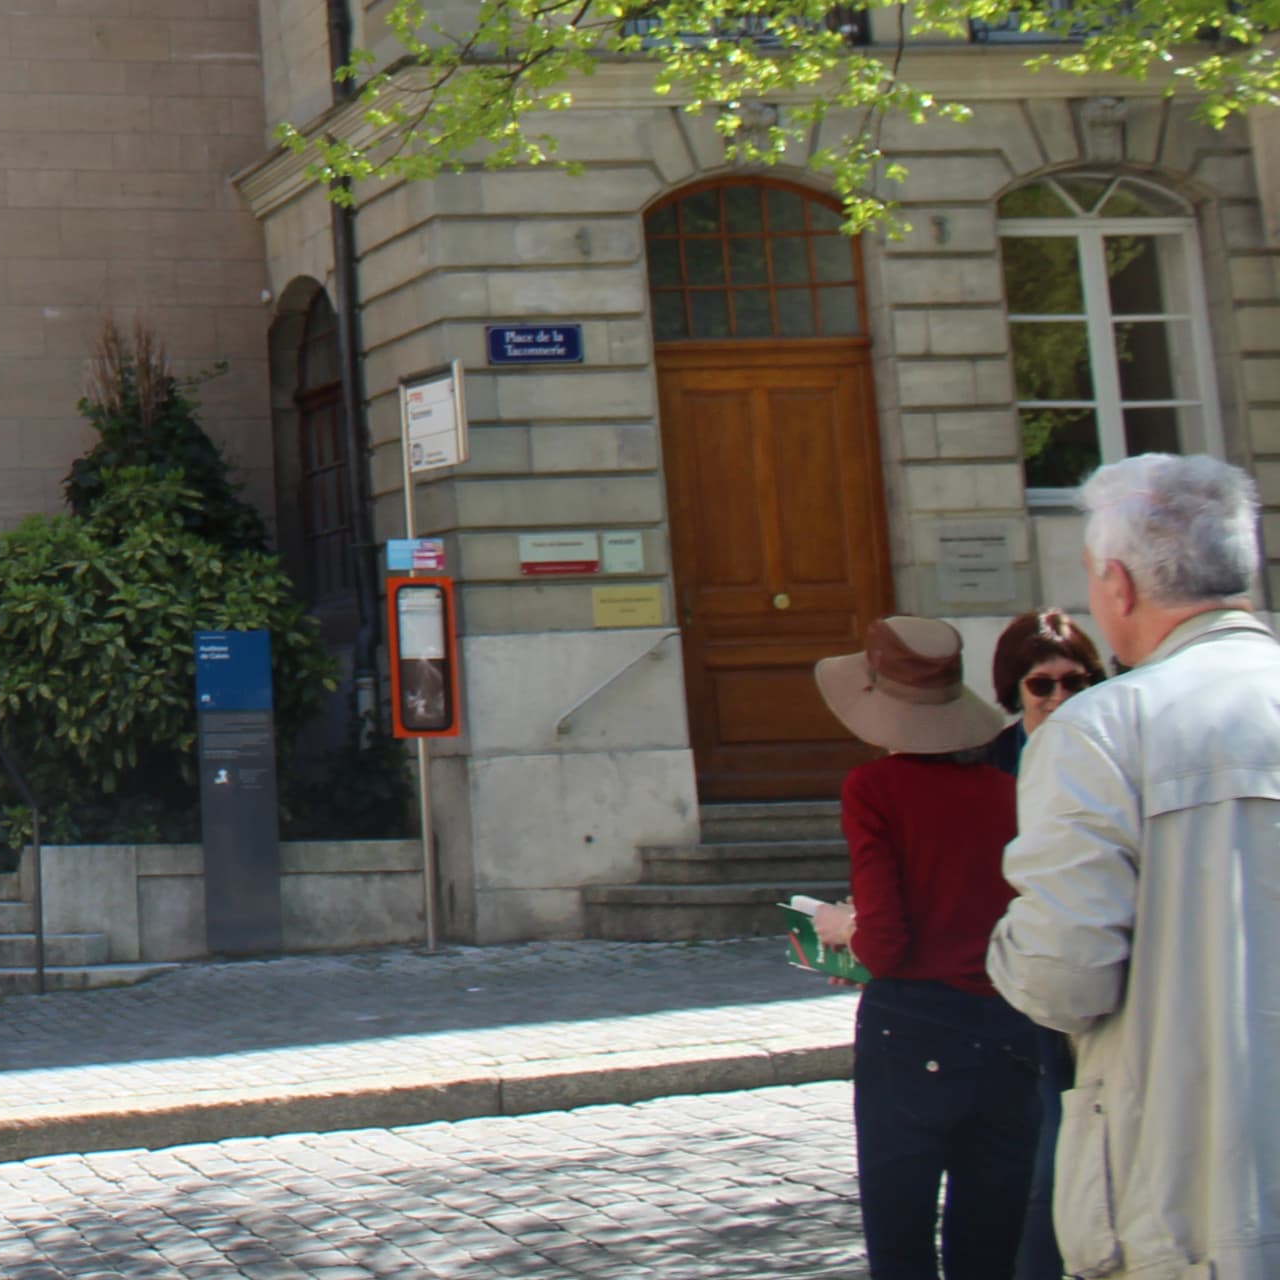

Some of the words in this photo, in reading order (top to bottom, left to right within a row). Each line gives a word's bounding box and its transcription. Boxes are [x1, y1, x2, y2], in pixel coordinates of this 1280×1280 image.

[504, 330, 533, 343] Place
[535, 330, 550, 343] de
[552, 330, 564, 342] la
[503, 344, 567, 356] Taconnerie
